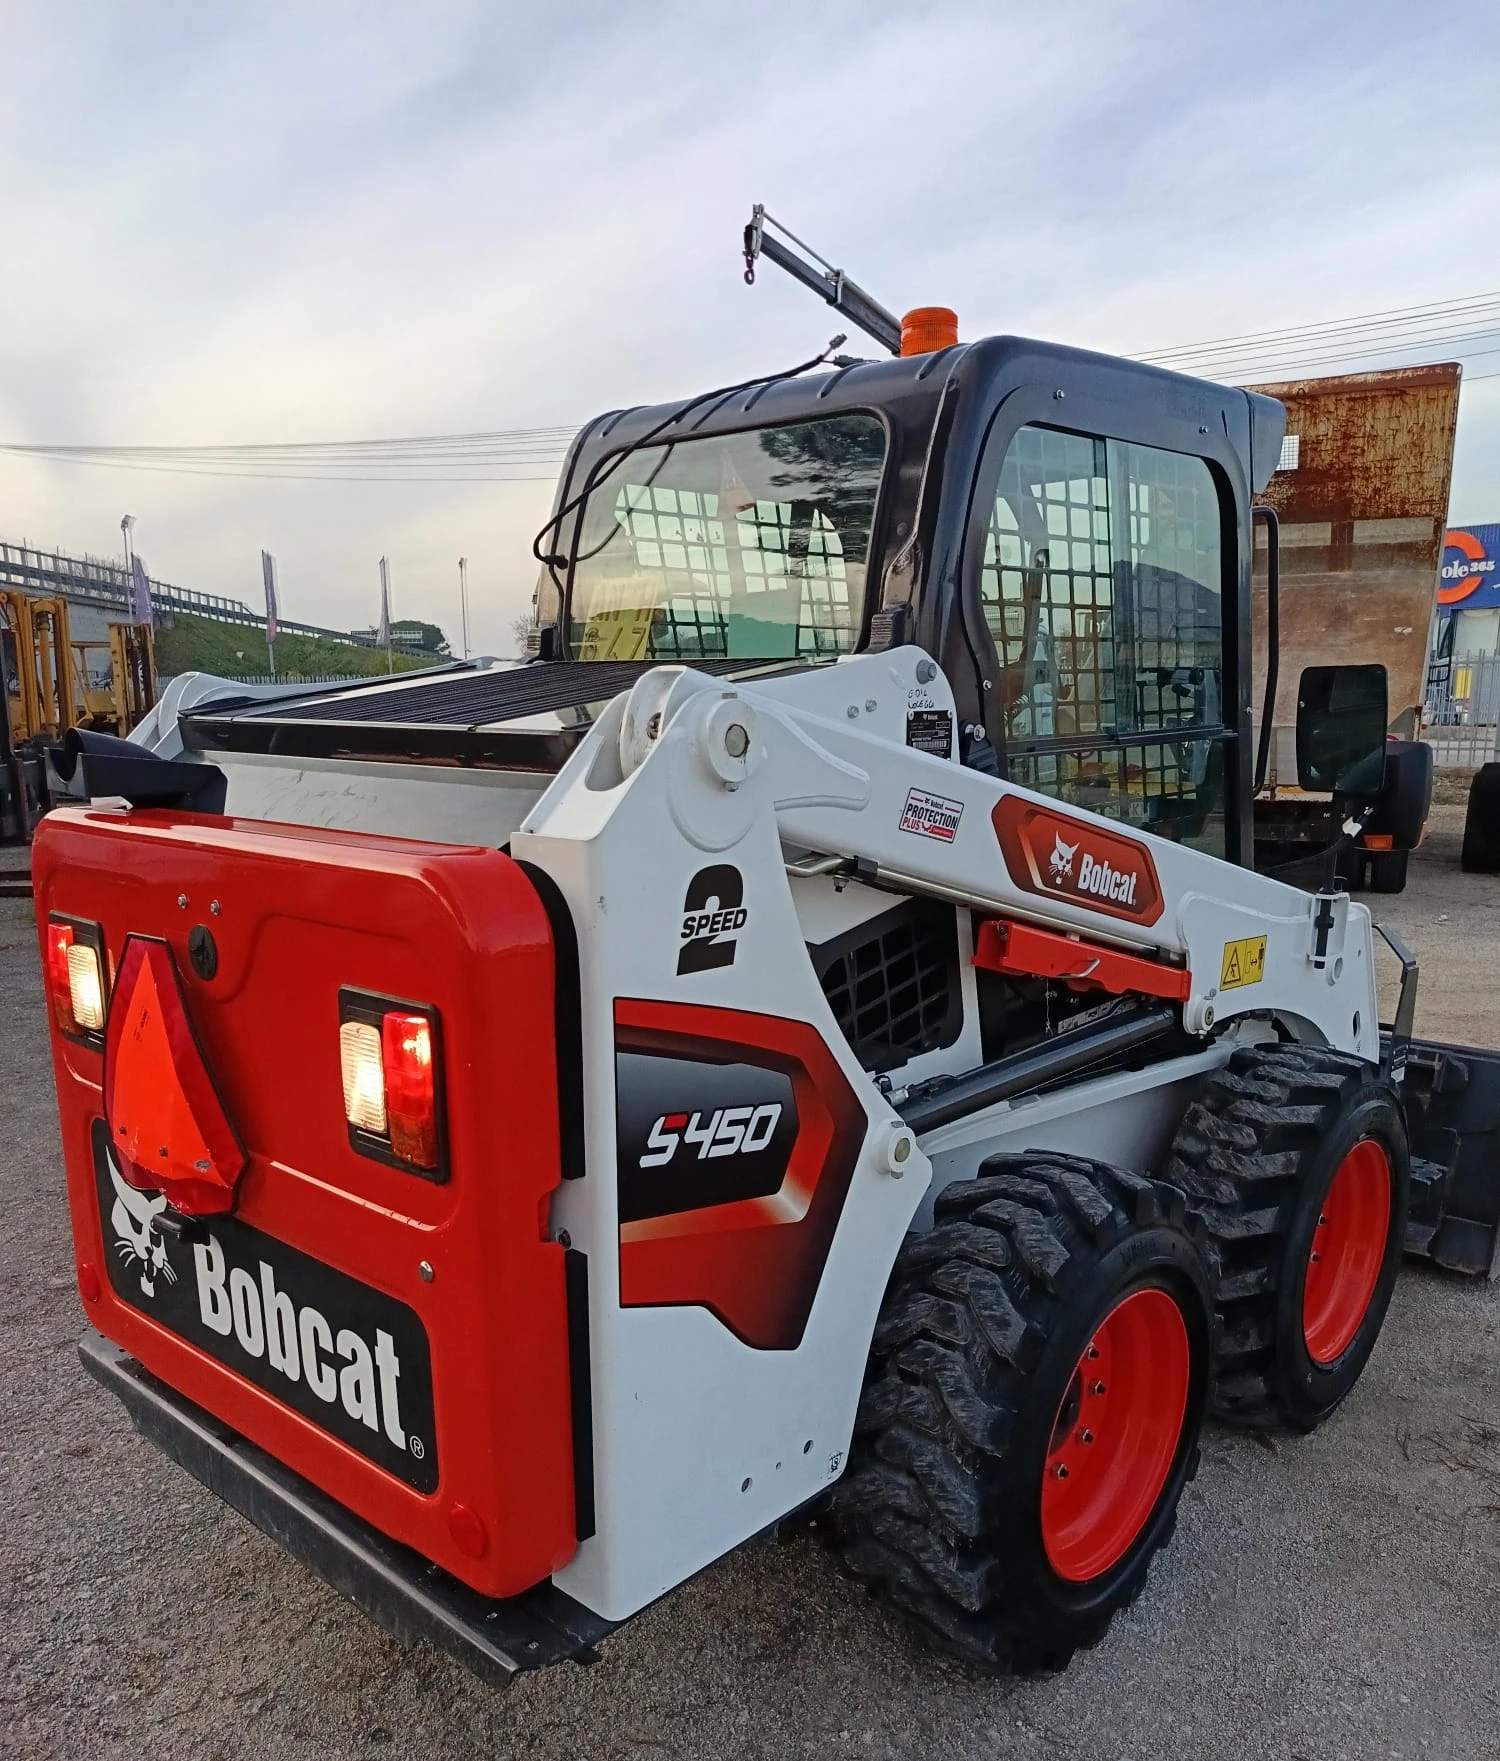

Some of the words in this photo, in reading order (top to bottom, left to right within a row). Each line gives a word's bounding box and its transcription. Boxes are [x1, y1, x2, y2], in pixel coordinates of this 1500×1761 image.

[902, 816, 921, 831] PLUS
[905, 803, 958, 829] PROTECTION
[1078, 853, 1137, 905] Bobcat
[680, 908, 748, 939] SPEED
[639, 1103, 782, 1168] S450
[193, 1233, 406, 1451] Bobcat
